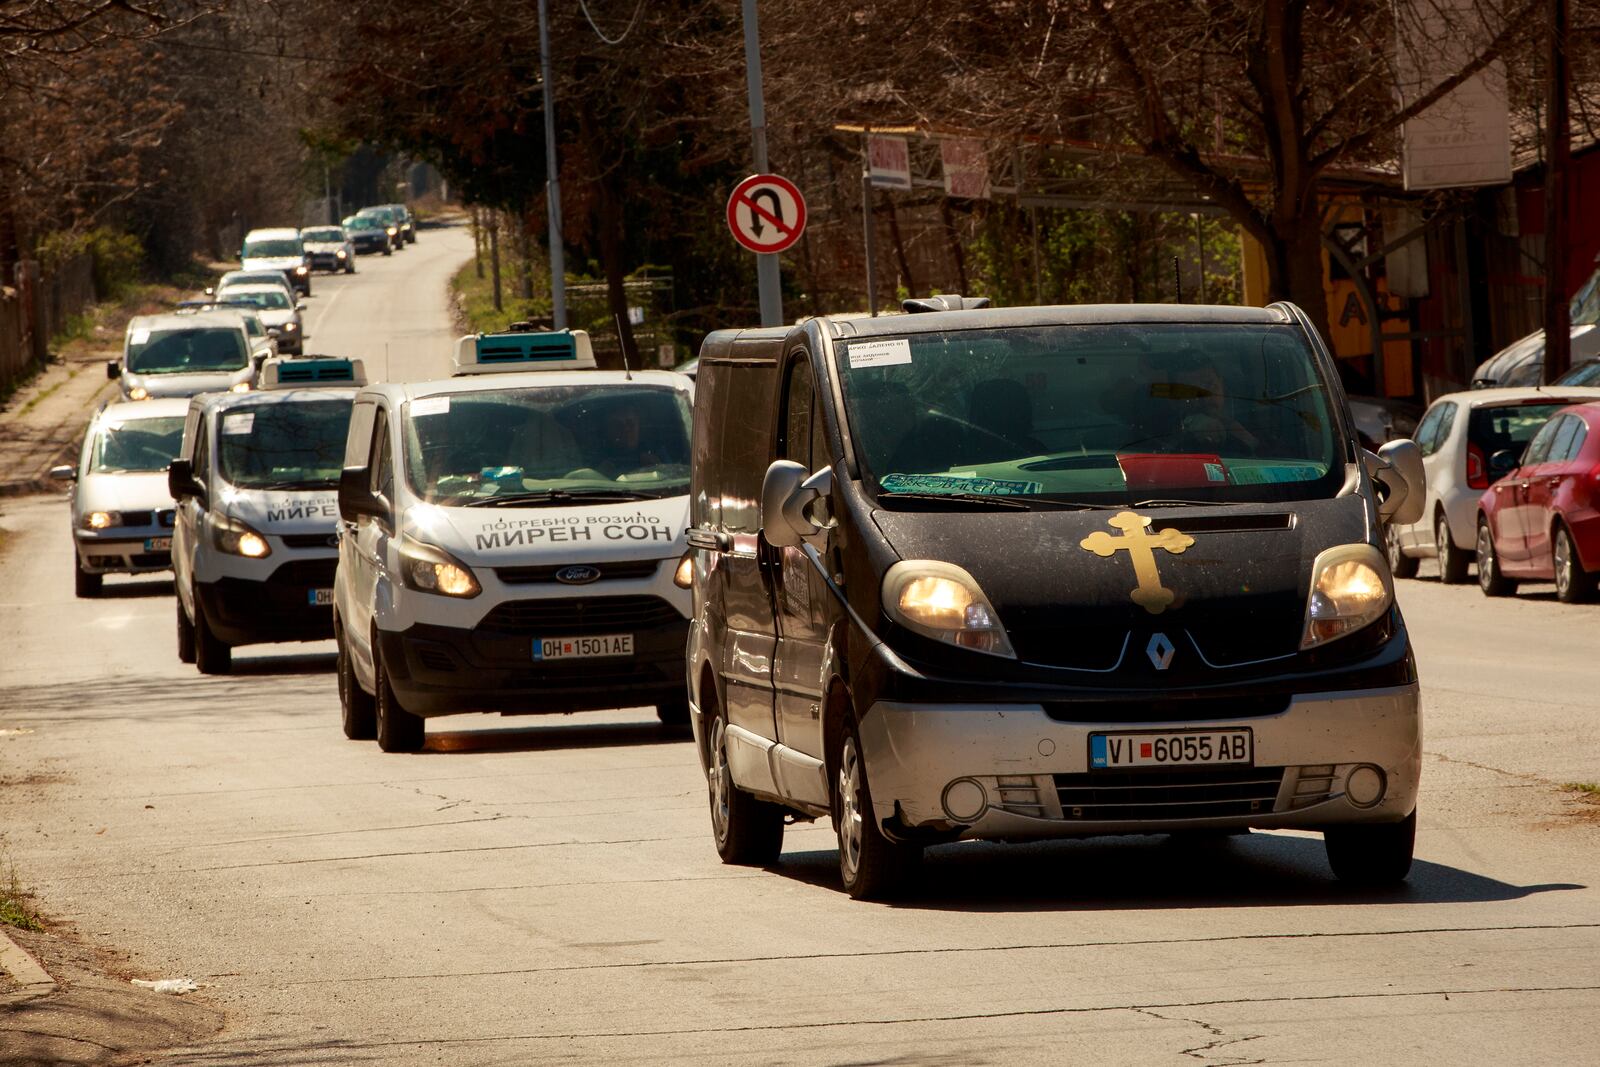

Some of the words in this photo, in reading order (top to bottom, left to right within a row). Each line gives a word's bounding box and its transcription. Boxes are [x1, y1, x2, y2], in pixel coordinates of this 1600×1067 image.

[267, 505, 337, 522] МИРЕ
[482, 516, 580, 532] ПОГРЕБНО
[586, 515, 660, 525] ВОЗИЛО
[476, 526, 591, 550] МИРЕН
[603, 525, 672, 542] СОН
[543, 641, 561, 657] OH
[574, 638, 609, 656] 1501
[613, 637, 631, 653] AE
[1109, 738, 1133, 763] VI
[1154, 736, 1212, 762] 6055
[1218, 735, 1246, 760] AB
